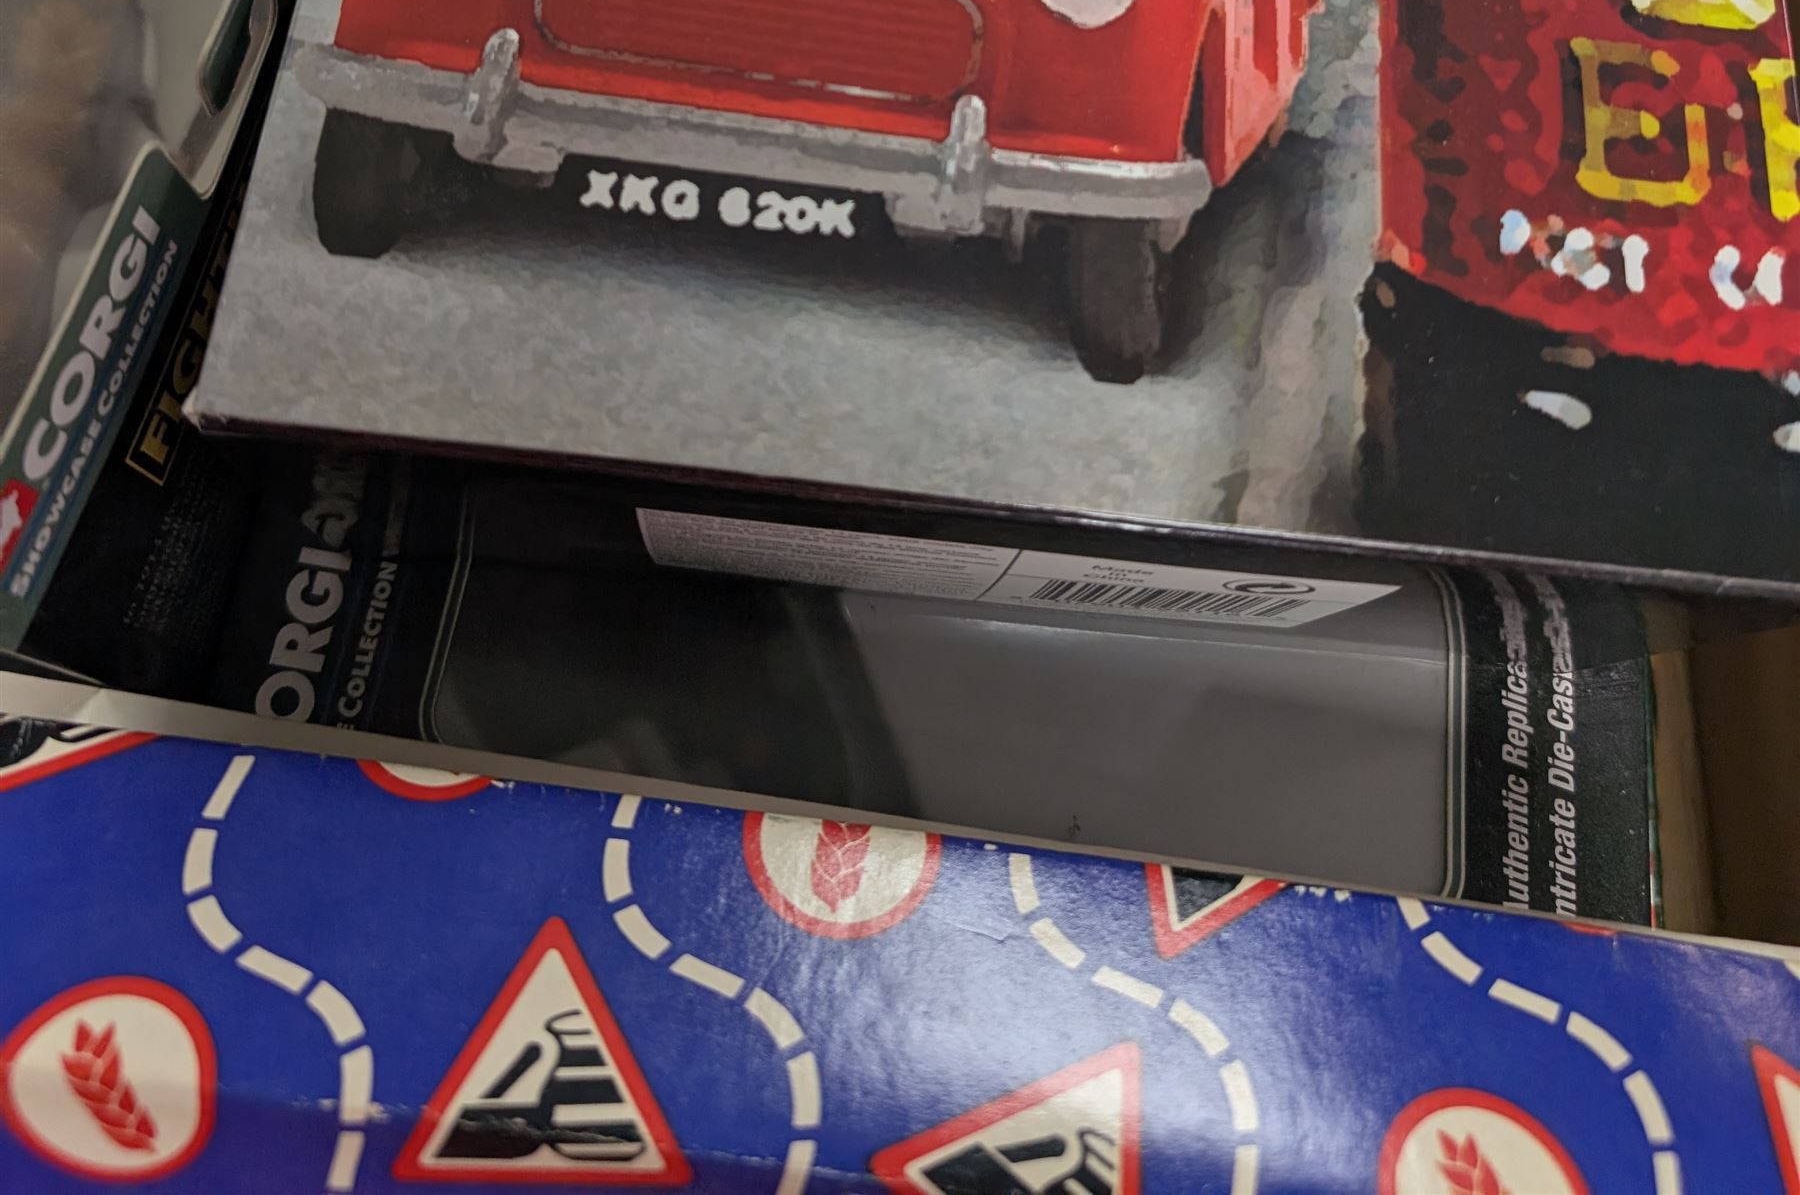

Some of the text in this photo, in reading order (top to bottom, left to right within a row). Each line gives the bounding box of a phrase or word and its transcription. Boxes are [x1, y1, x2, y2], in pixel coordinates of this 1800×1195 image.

[10, 418, 103, 598] SHOWCASE
[99, 240, 178, 416] COLLECTION
[22, 205, 160, 481] CORGI
[255, 547, 353, 722] ORGI
[337, 561, 399, 718] COLLECTION
[1545, 797, 1577, 919] ntricate
